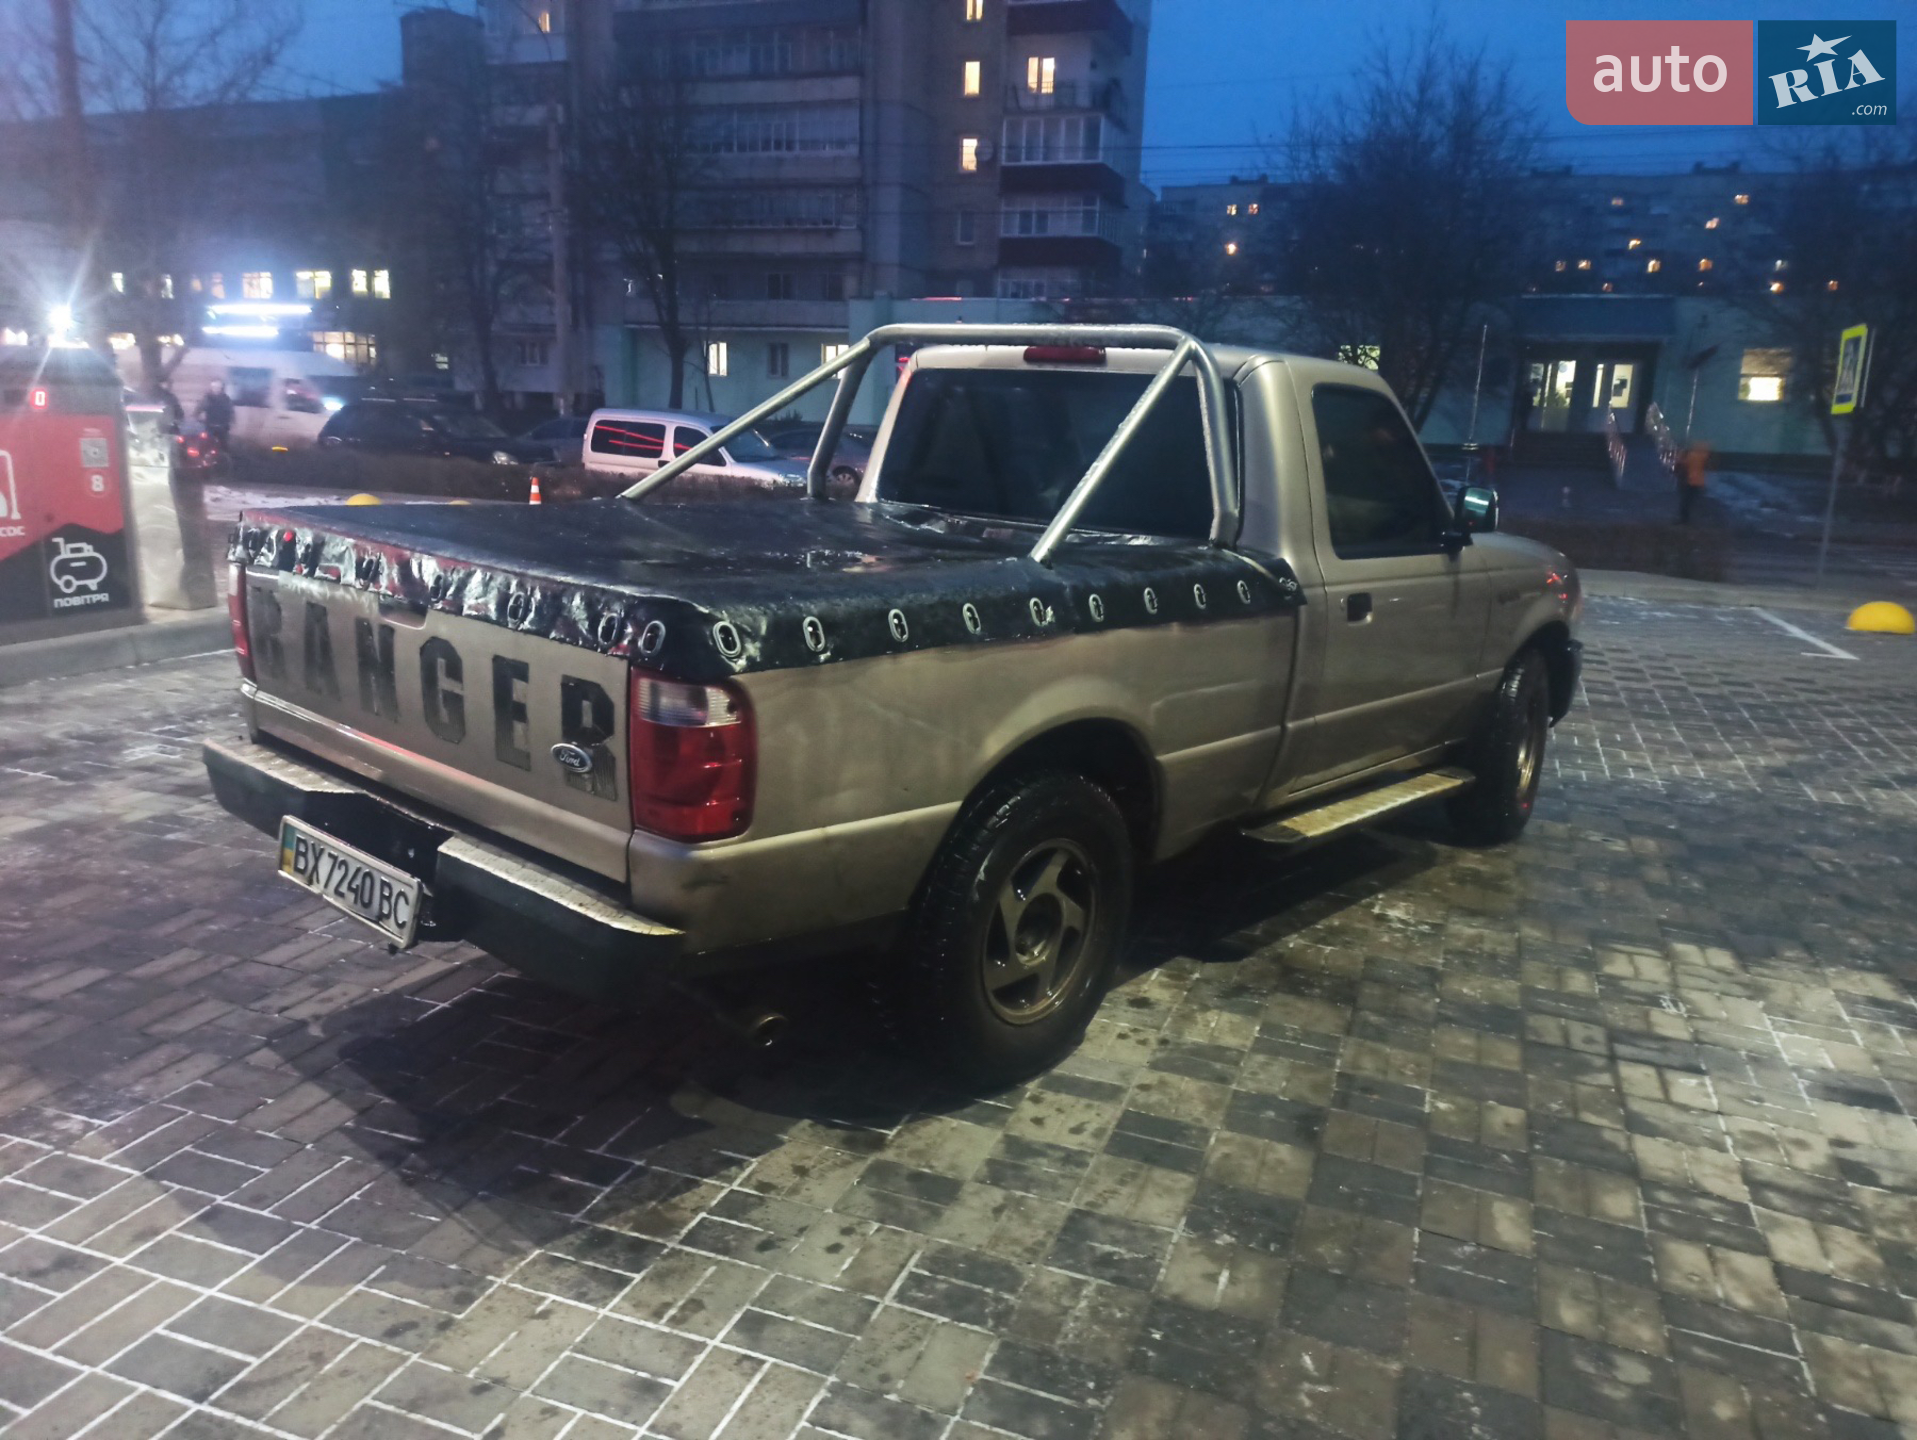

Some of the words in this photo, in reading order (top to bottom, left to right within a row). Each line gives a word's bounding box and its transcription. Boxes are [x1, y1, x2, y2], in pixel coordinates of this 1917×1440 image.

[91, 474, 104, 492] 8
[54, 593, 109, 608] ПОВІТРЯ
[251, 585, 618, 801] RANGER
